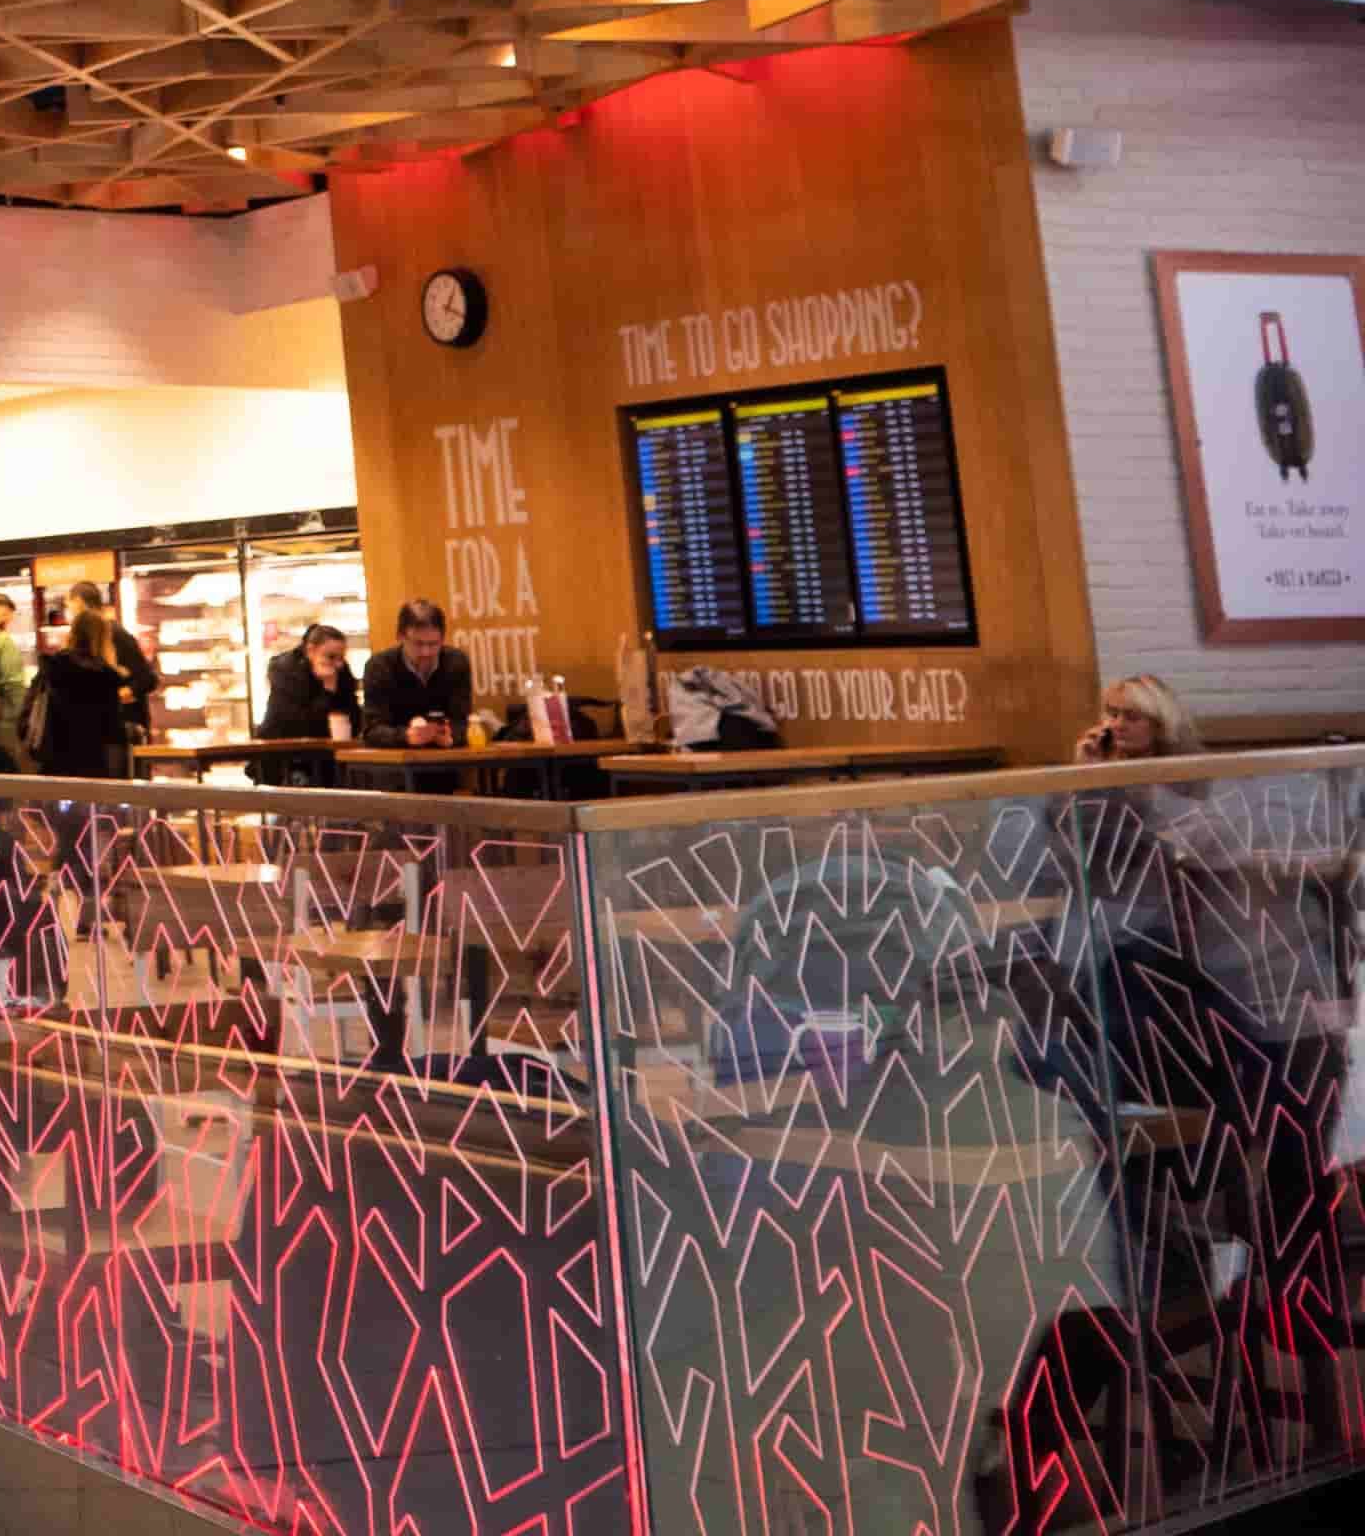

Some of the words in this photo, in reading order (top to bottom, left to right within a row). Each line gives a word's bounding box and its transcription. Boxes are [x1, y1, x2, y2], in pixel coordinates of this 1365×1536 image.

[617, 320, 678, 388] TIME
[680, 313, 718, 378] TO
[722, 306, 762, 374] GO
[765, 279, 923, 366] SHOPPING?
[433, 415, 530, 529] TIME
[444, 534, 507, 620] FOR
[516, 535, 541, 618] A
[453, 626, 542, 697] OFFEE
[770, 667, 799, 721] GO
[801, 667, 833, 721] TO
[836, 667, 897, 721] YOUR
[900, 666, 969, 722] GATE?
